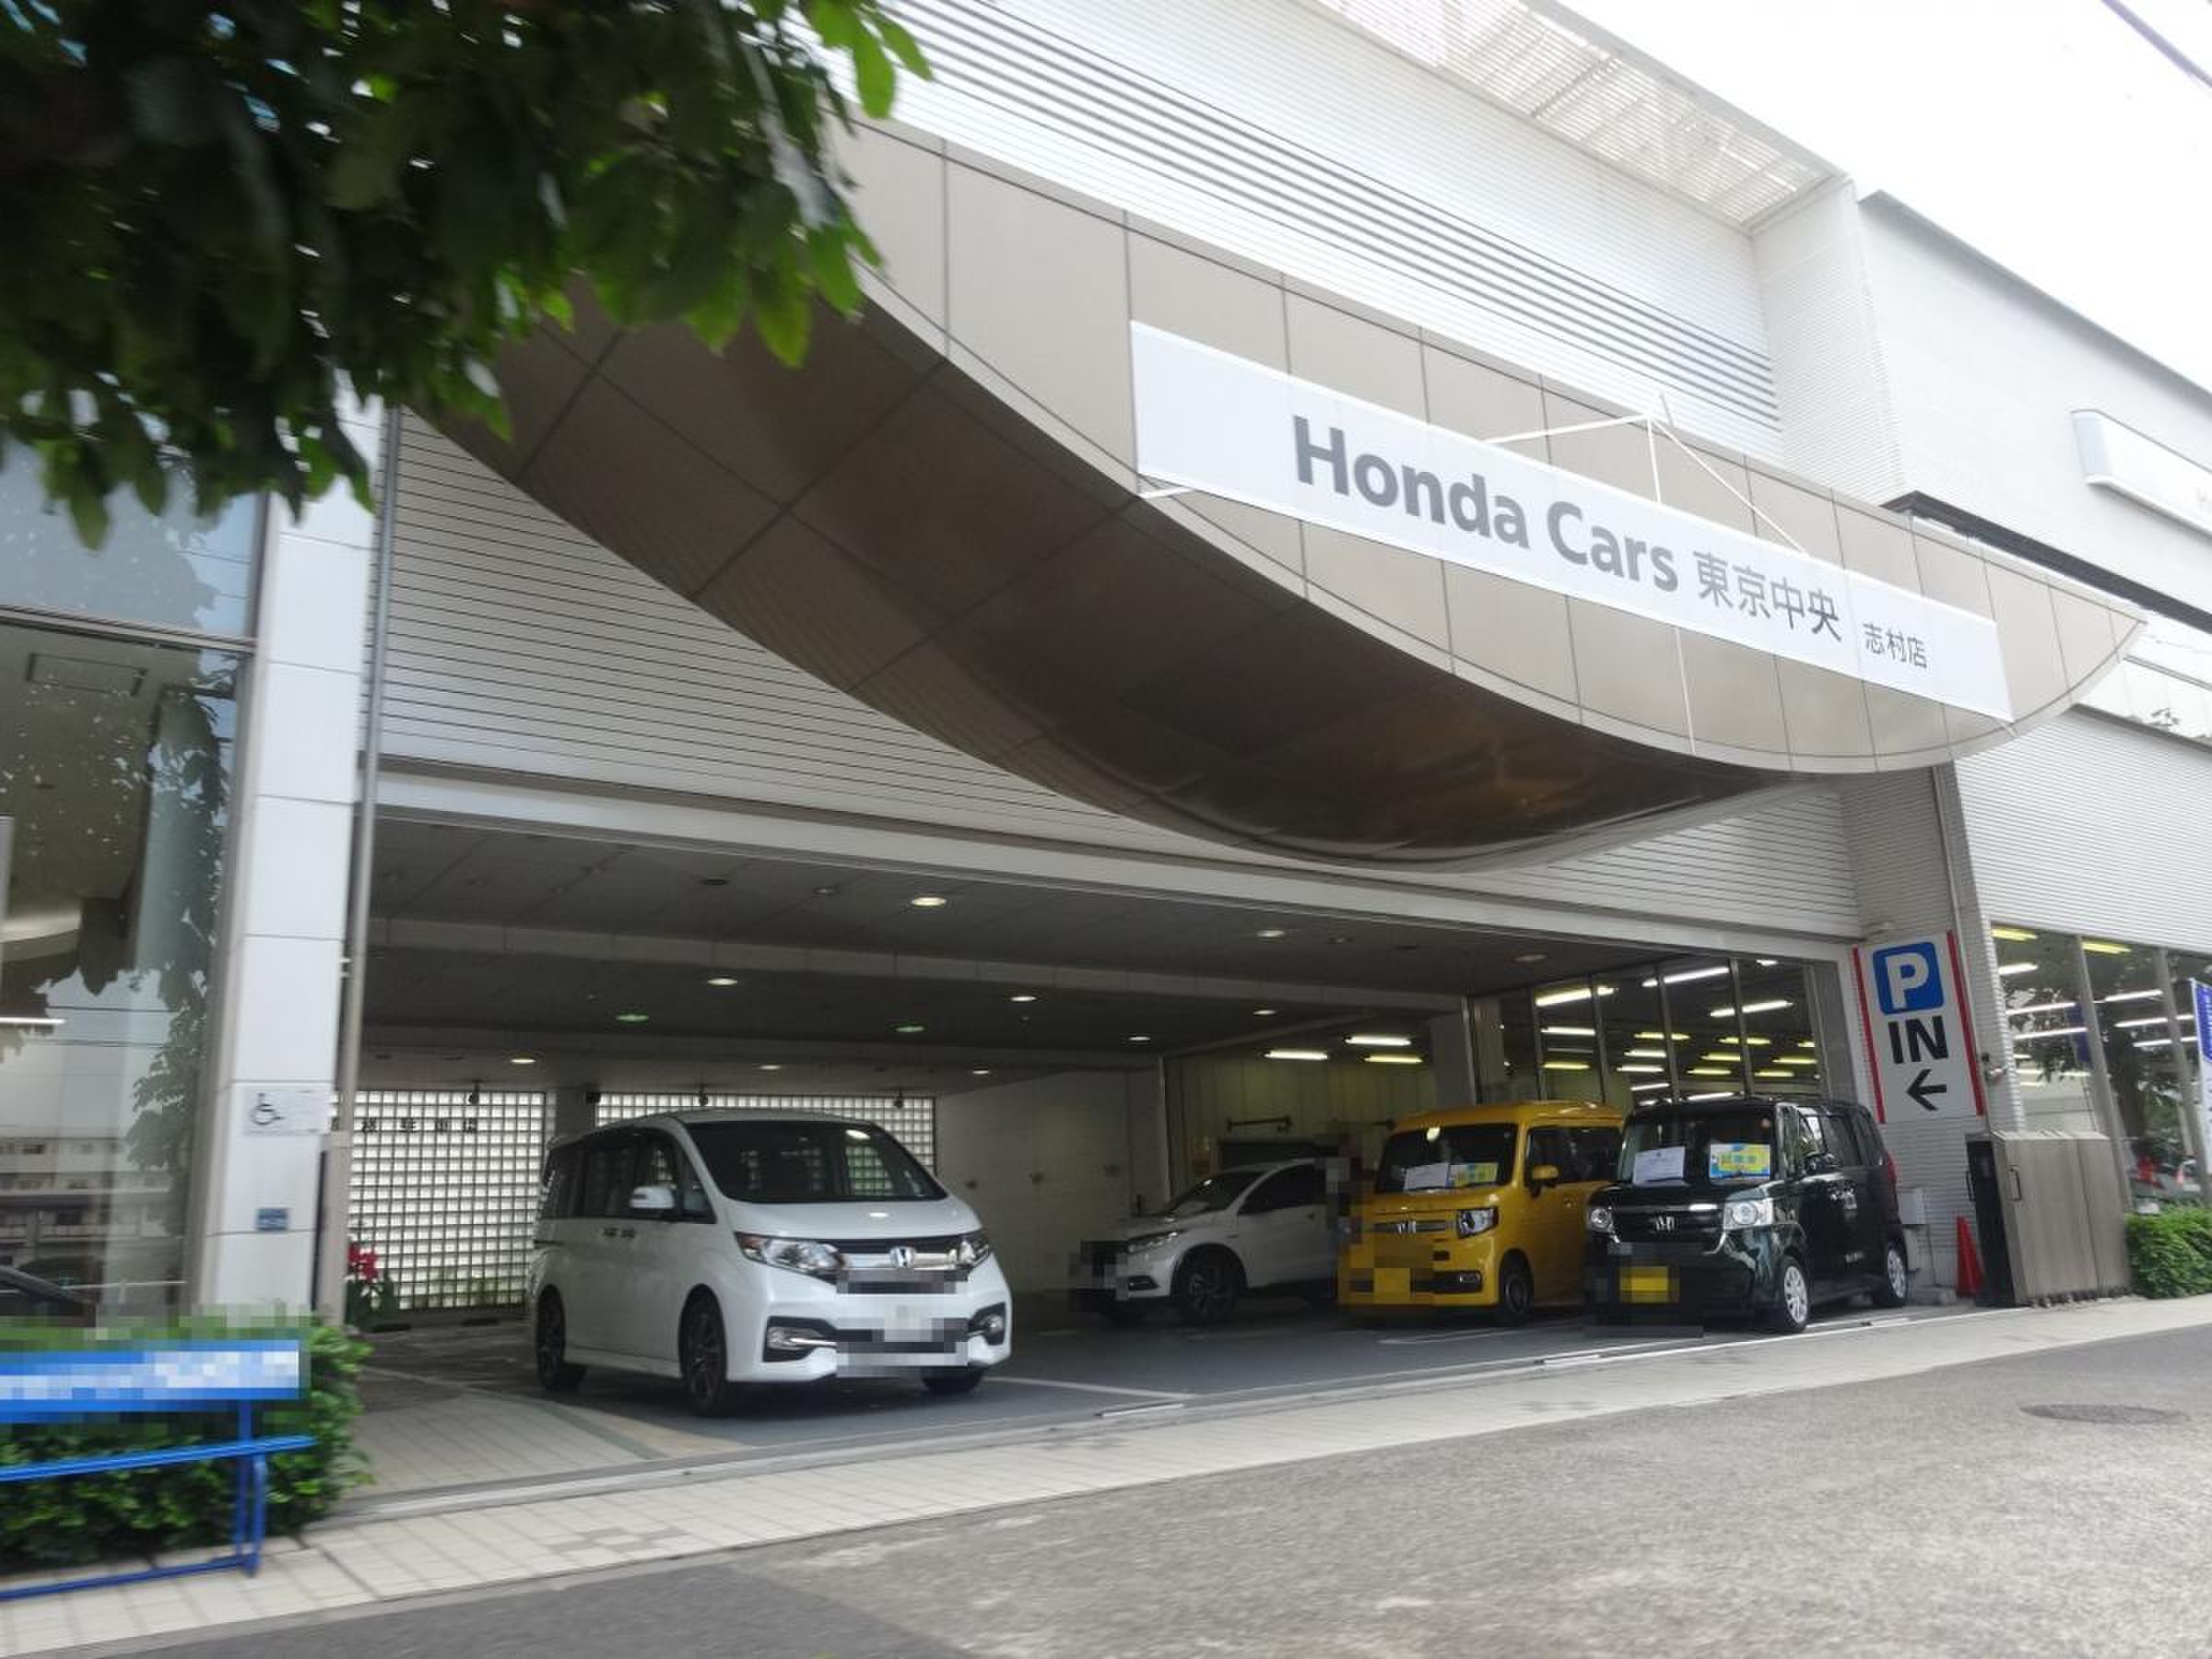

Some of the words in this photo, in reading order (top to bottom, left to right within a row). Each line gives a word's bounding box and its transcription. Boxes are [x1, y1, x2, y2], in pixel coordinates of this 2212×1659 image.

[1292, 414, 1531, 550] Honda
[1547, 500, 1679, 593] Cars
[1691, 549, 1842, 642] 東京中央
[1862, 621, 1928, 669] 志村店
[1885, 952, 1930, 1009] P
[1887, 1015, 1949, 1065] IN
